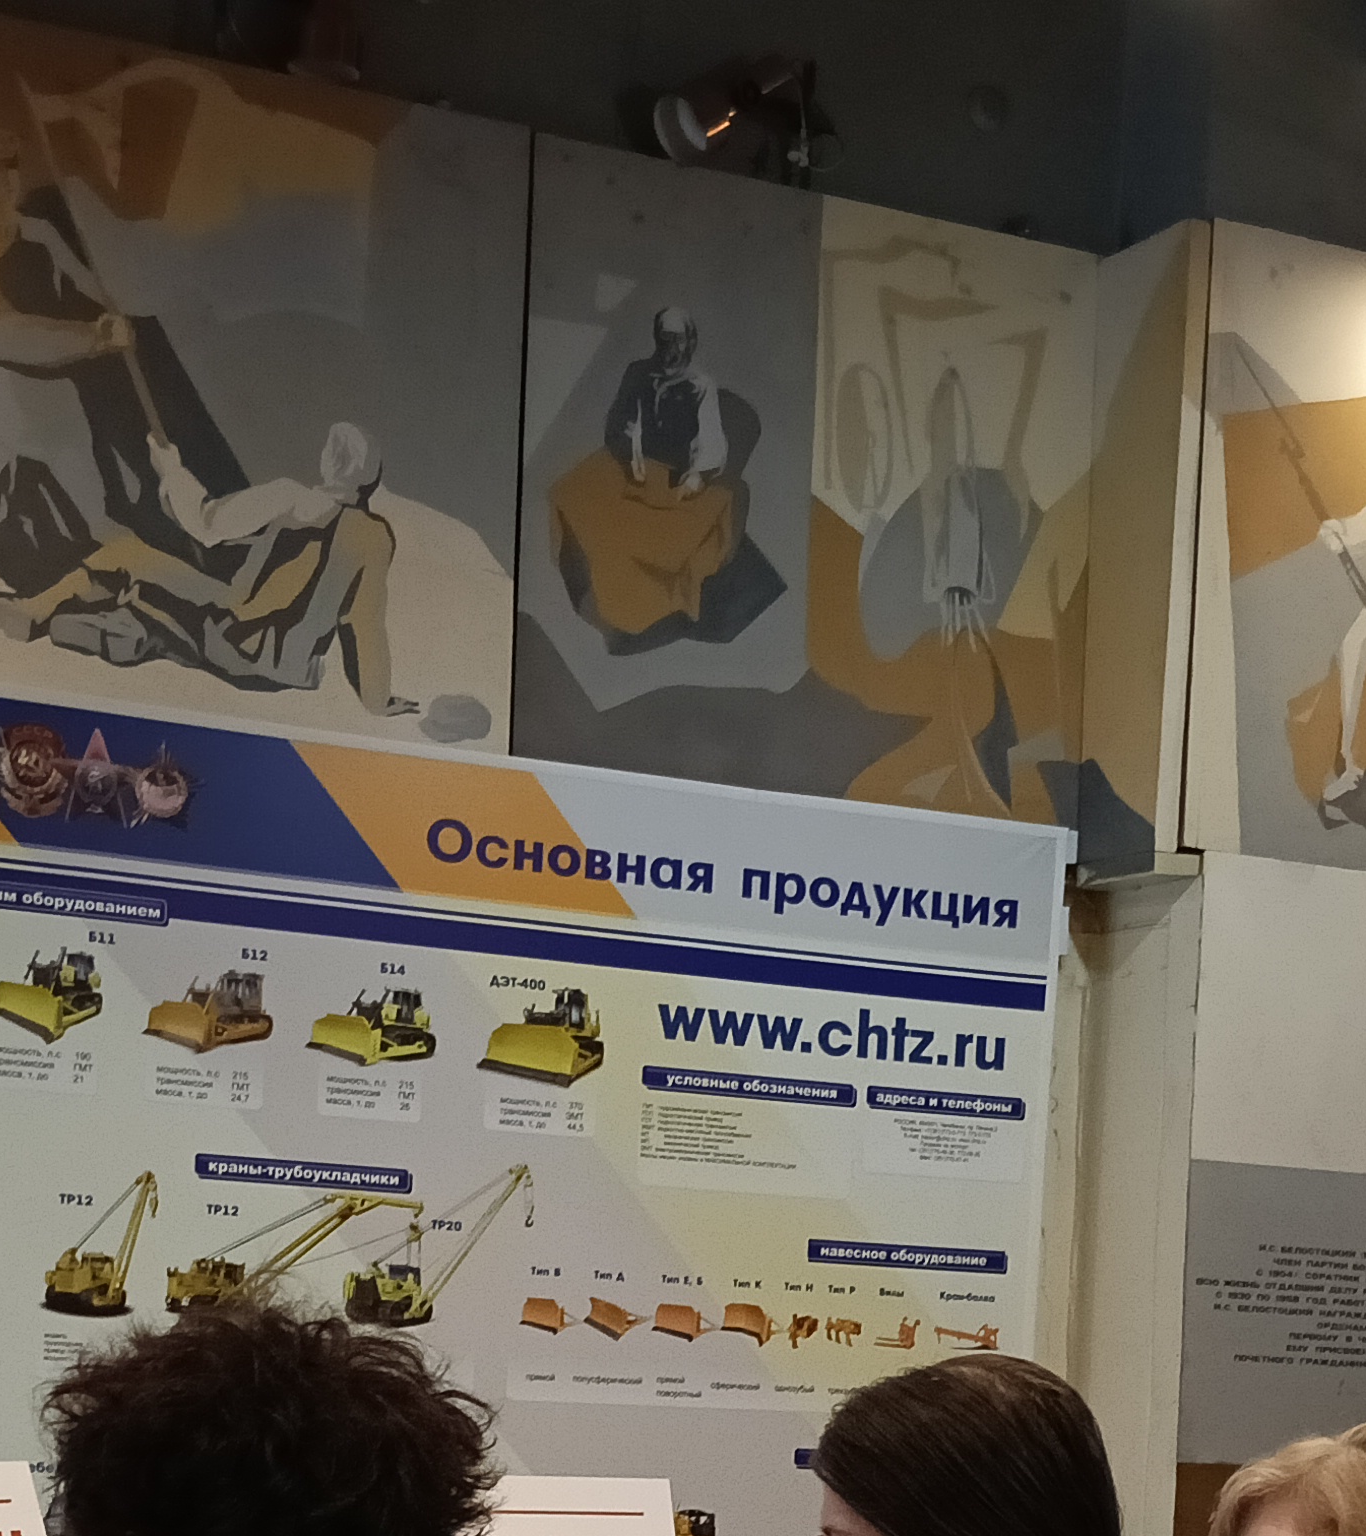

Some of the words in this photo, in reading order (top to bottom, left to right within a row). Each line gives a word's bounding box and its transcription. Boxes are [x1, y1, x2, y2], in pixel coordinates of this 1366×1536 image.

[426, 818, 714, 894] Основная
[741, 867, 1018, 928] продукция
[22, 891, 160, 918] оборудованием
[88, 930, 115, 944] Б11
[241, 947, 267, 961] Б12
[380, 962, 405, 975] Б14
[489, 974, 545, 990] ДЭТ-400
[657, 1001, 1008, 1073] www.chtz.ru
[666, 1073, 738, 1091] условные
[741, 1078, 837, 1099] обозначения
[875, 1092, 925, 1111] адреса
[928, 1097, 937, 1106] и
[941, 1098, 1012, 1113] телефоны
[208, 1161, 399, 1185] краны-трубоукладчики
[58, 1193, 93, 1206] ТР12
[206, 1203, 238, 1216] ТР12
[820, 1247, 886, 1259] навесное
[890, 1250, 986, 1266] оборудование
[531, 1266, 549, 1276] Тип
[594, 1269, 612, 1279] Тип
[661, 1274, 679, 1283] Тип
[733, 1278, 750, 1288] Тип
[784, 1281, 801, 1291] Тип
[827, 1284, 845, 1294] Тип
